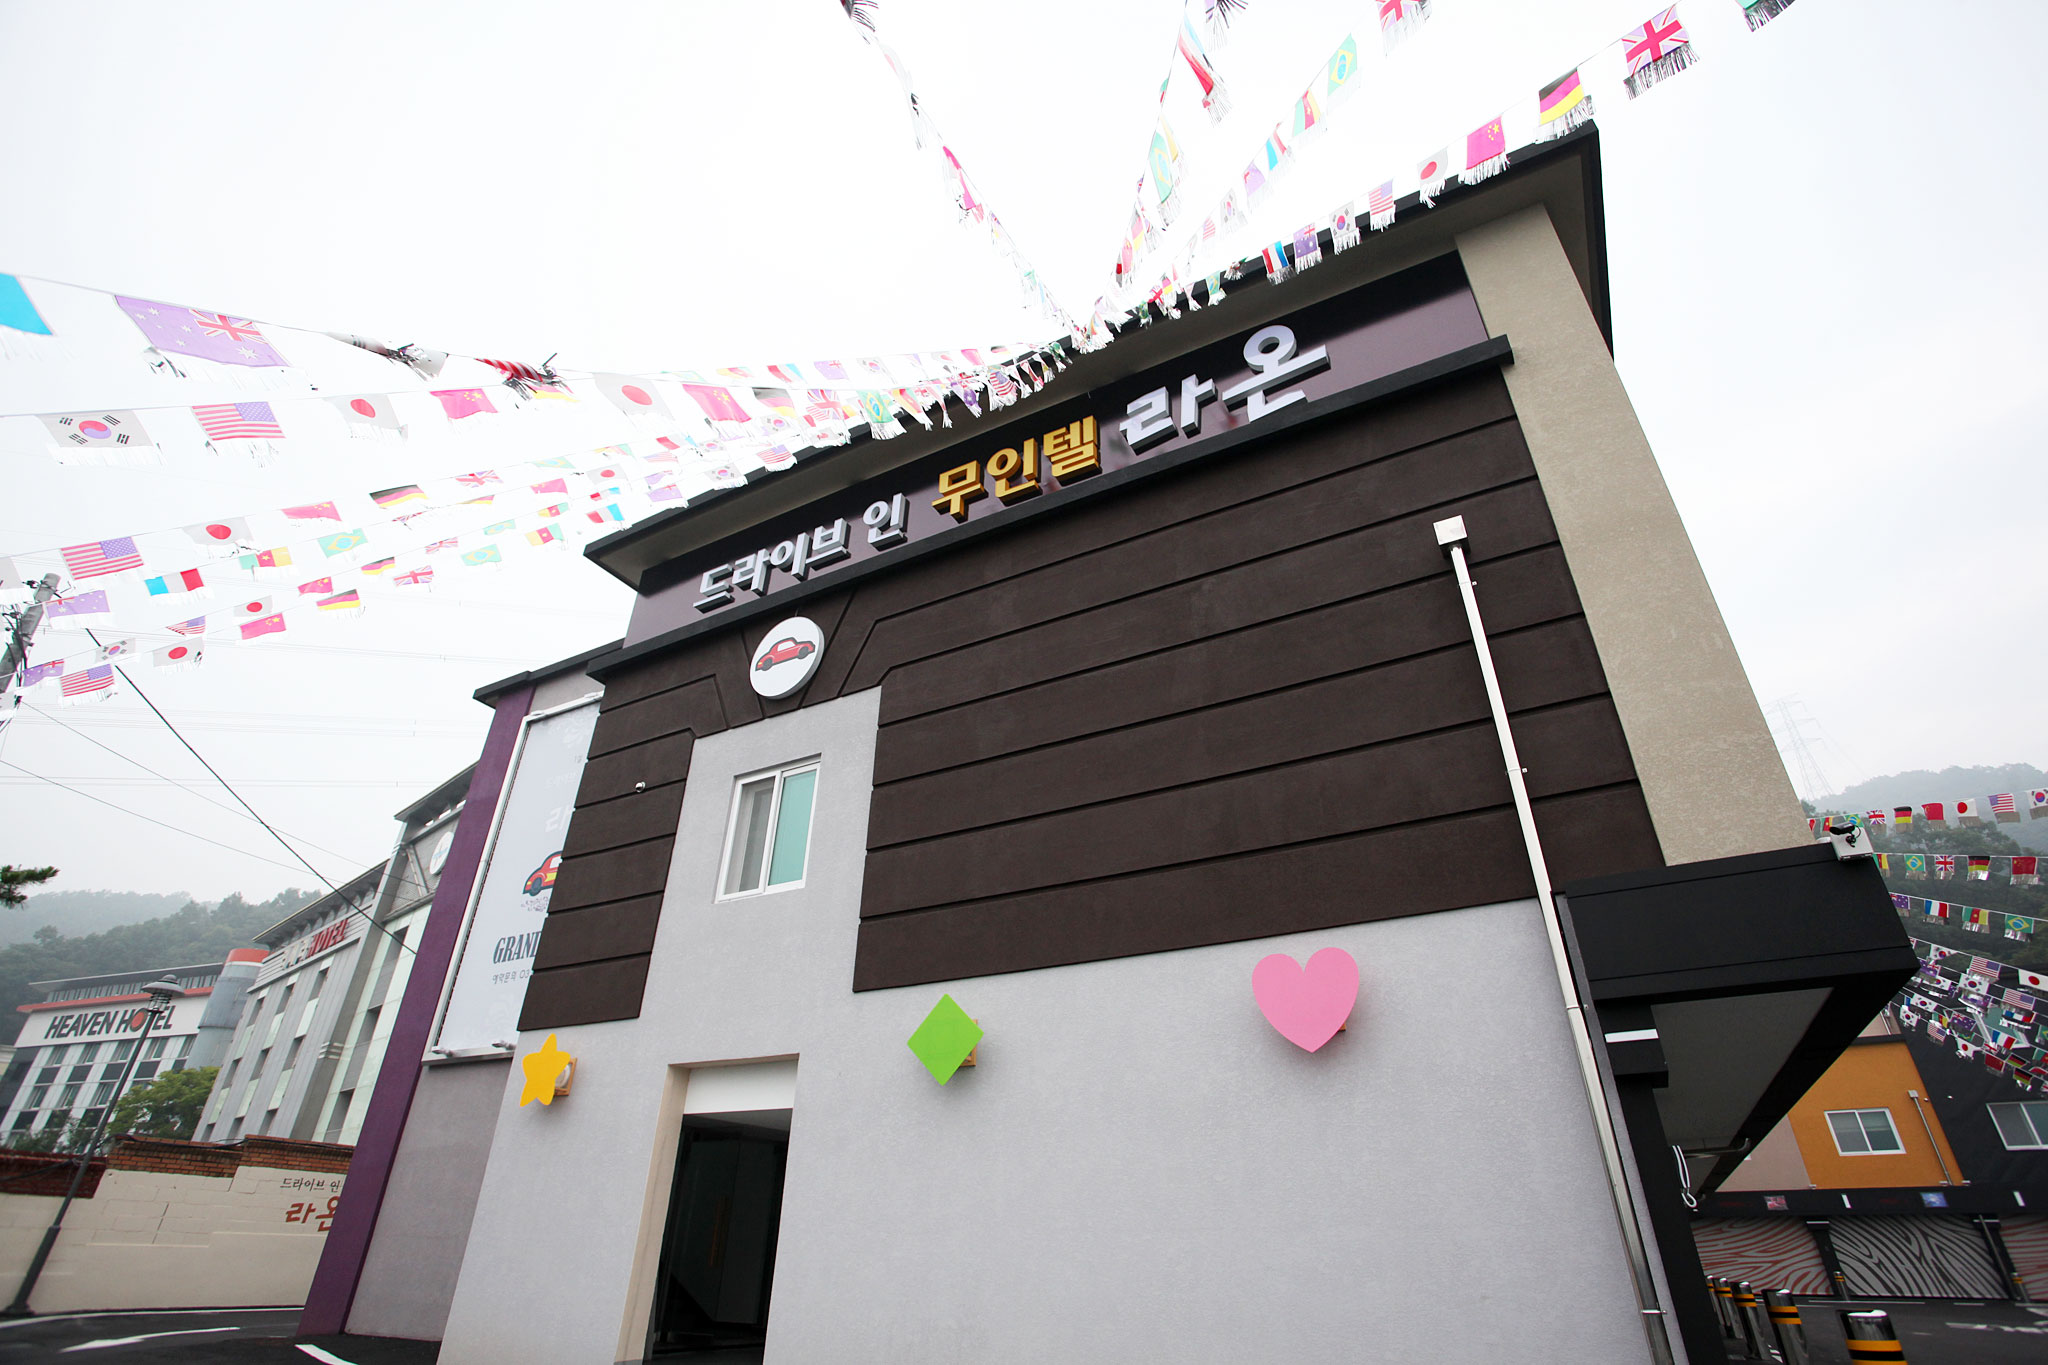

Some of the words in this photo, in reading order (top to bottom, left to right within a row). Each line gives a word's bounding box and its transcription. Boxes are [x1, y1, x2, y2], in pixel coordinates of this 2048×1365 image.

[692, 517, 850, 609] 드라이브
[862, 492, 909, 547] 인
[931, 415, 1102, 521] 무인텔
[1119, 324, 1331, 450] 라온
[307, 918, 349, 958] HOTEL
[44, 1010, 119, 1039] HEAVEN
[114, 1004, 177, 1034] HOEL
[279, 1177, 325, 1192] 드라이브
[329, 1179, 341, 1193] 인
